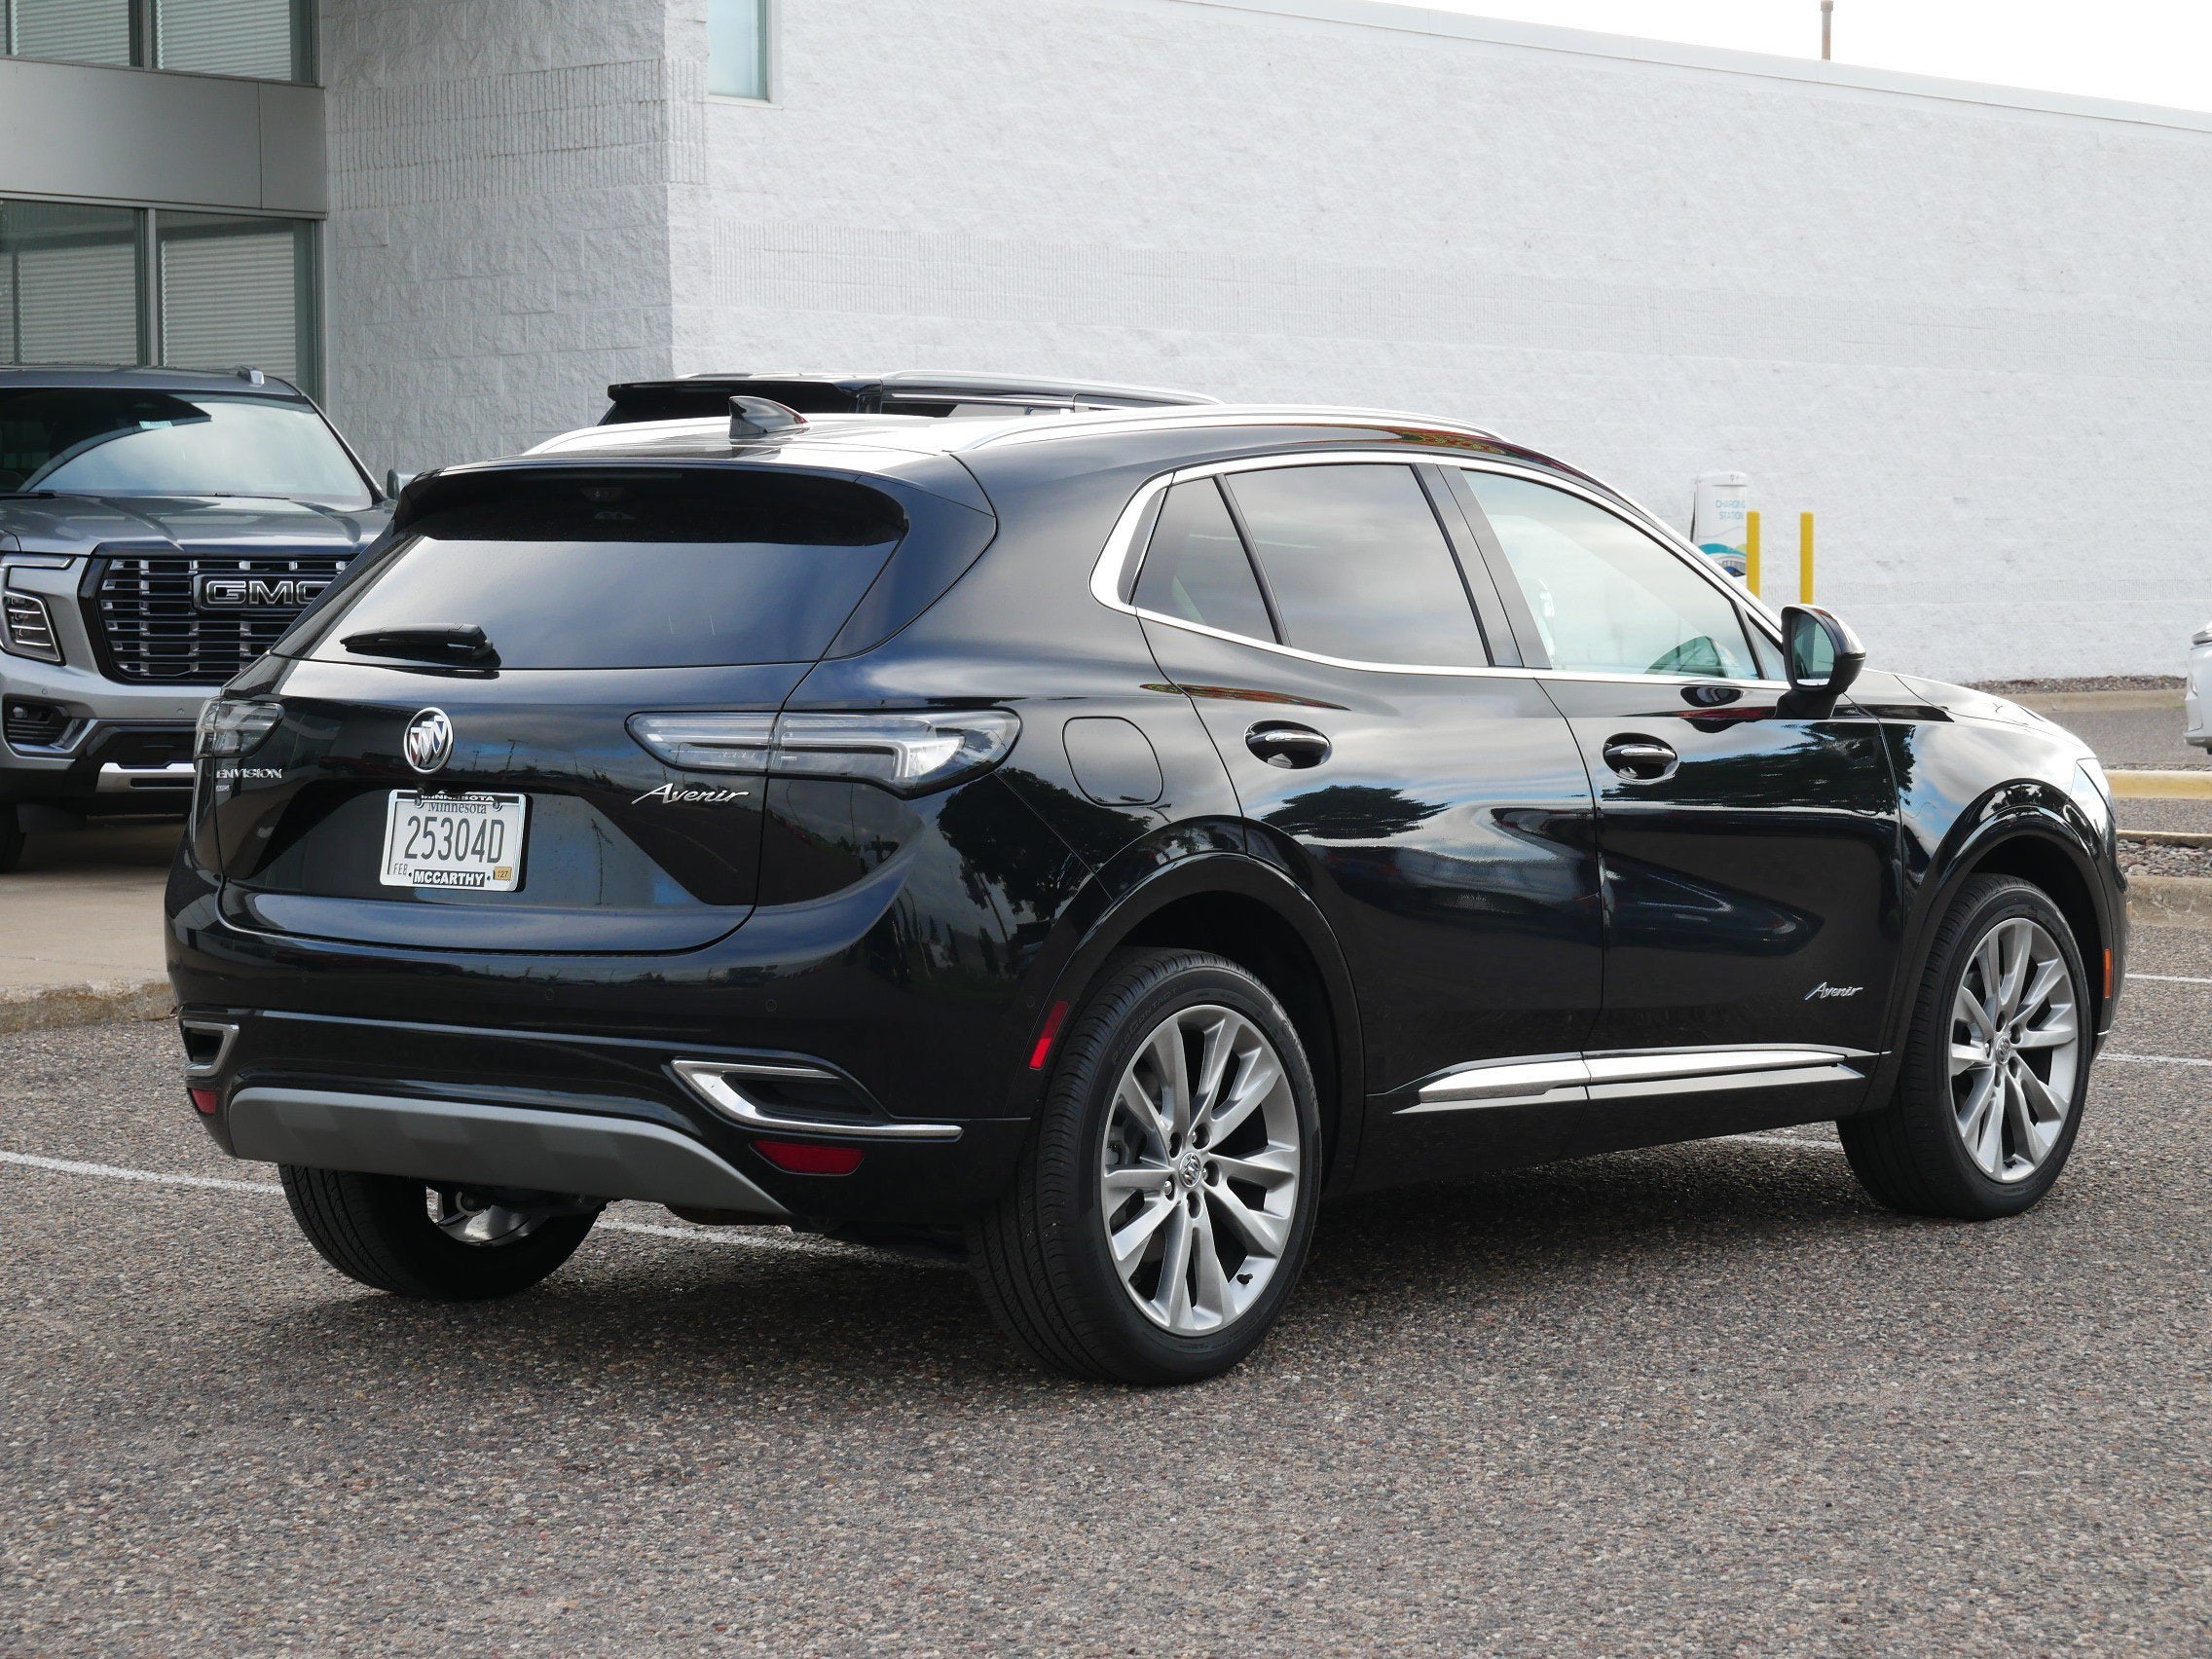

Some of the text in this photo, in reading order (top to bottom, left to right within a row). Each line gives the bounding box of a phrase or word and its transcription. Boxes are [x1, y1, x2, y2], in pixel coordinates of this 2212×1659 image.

[1718, 511, 1744, 520] STATION
[206, 580, 332, 605] GMC
[216, 768, 283, 779] ENVISION
[631, 783, 750, 805] Avenir
[428, 802, 487, 814] Minnesota
[404, 815, 505, 864] 25304D
[393, 863, 408, 875] FEB
[414, 870, 484, 886] MCCARTHY
[1804, 981, 1863, 1001] Avenir
